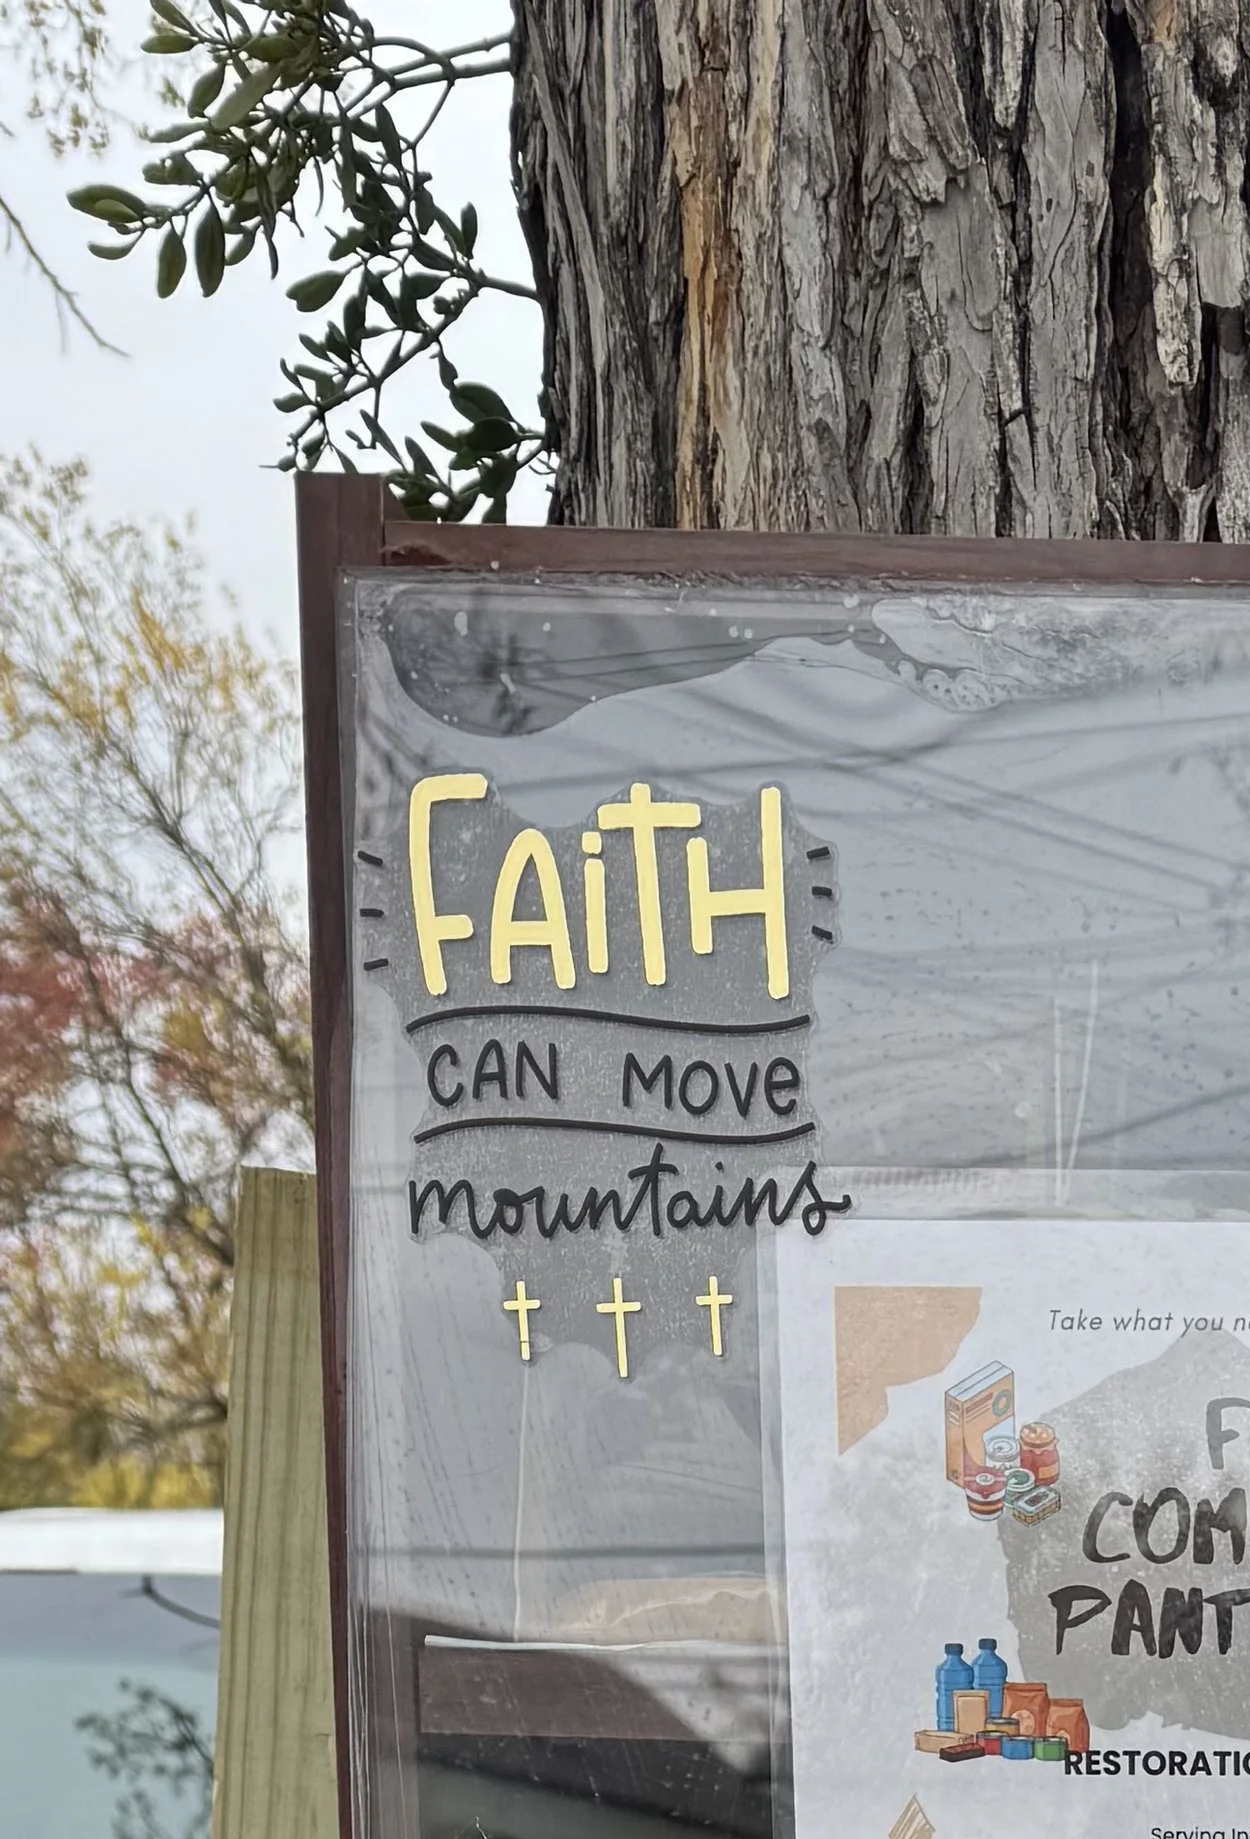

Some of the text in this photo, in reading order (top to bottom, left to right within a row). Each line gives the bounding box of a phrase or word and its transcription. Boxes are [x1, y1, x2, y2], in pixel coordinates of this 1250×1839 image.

[427, 1038, 558, 1107] CAN
[409, 1144, 852, 1239] mountains
[1049, 1309, 1103, 1333] Take
[1112, 1309, 1174, 1333] what
[1180, 1315, 1224, 1338] you
